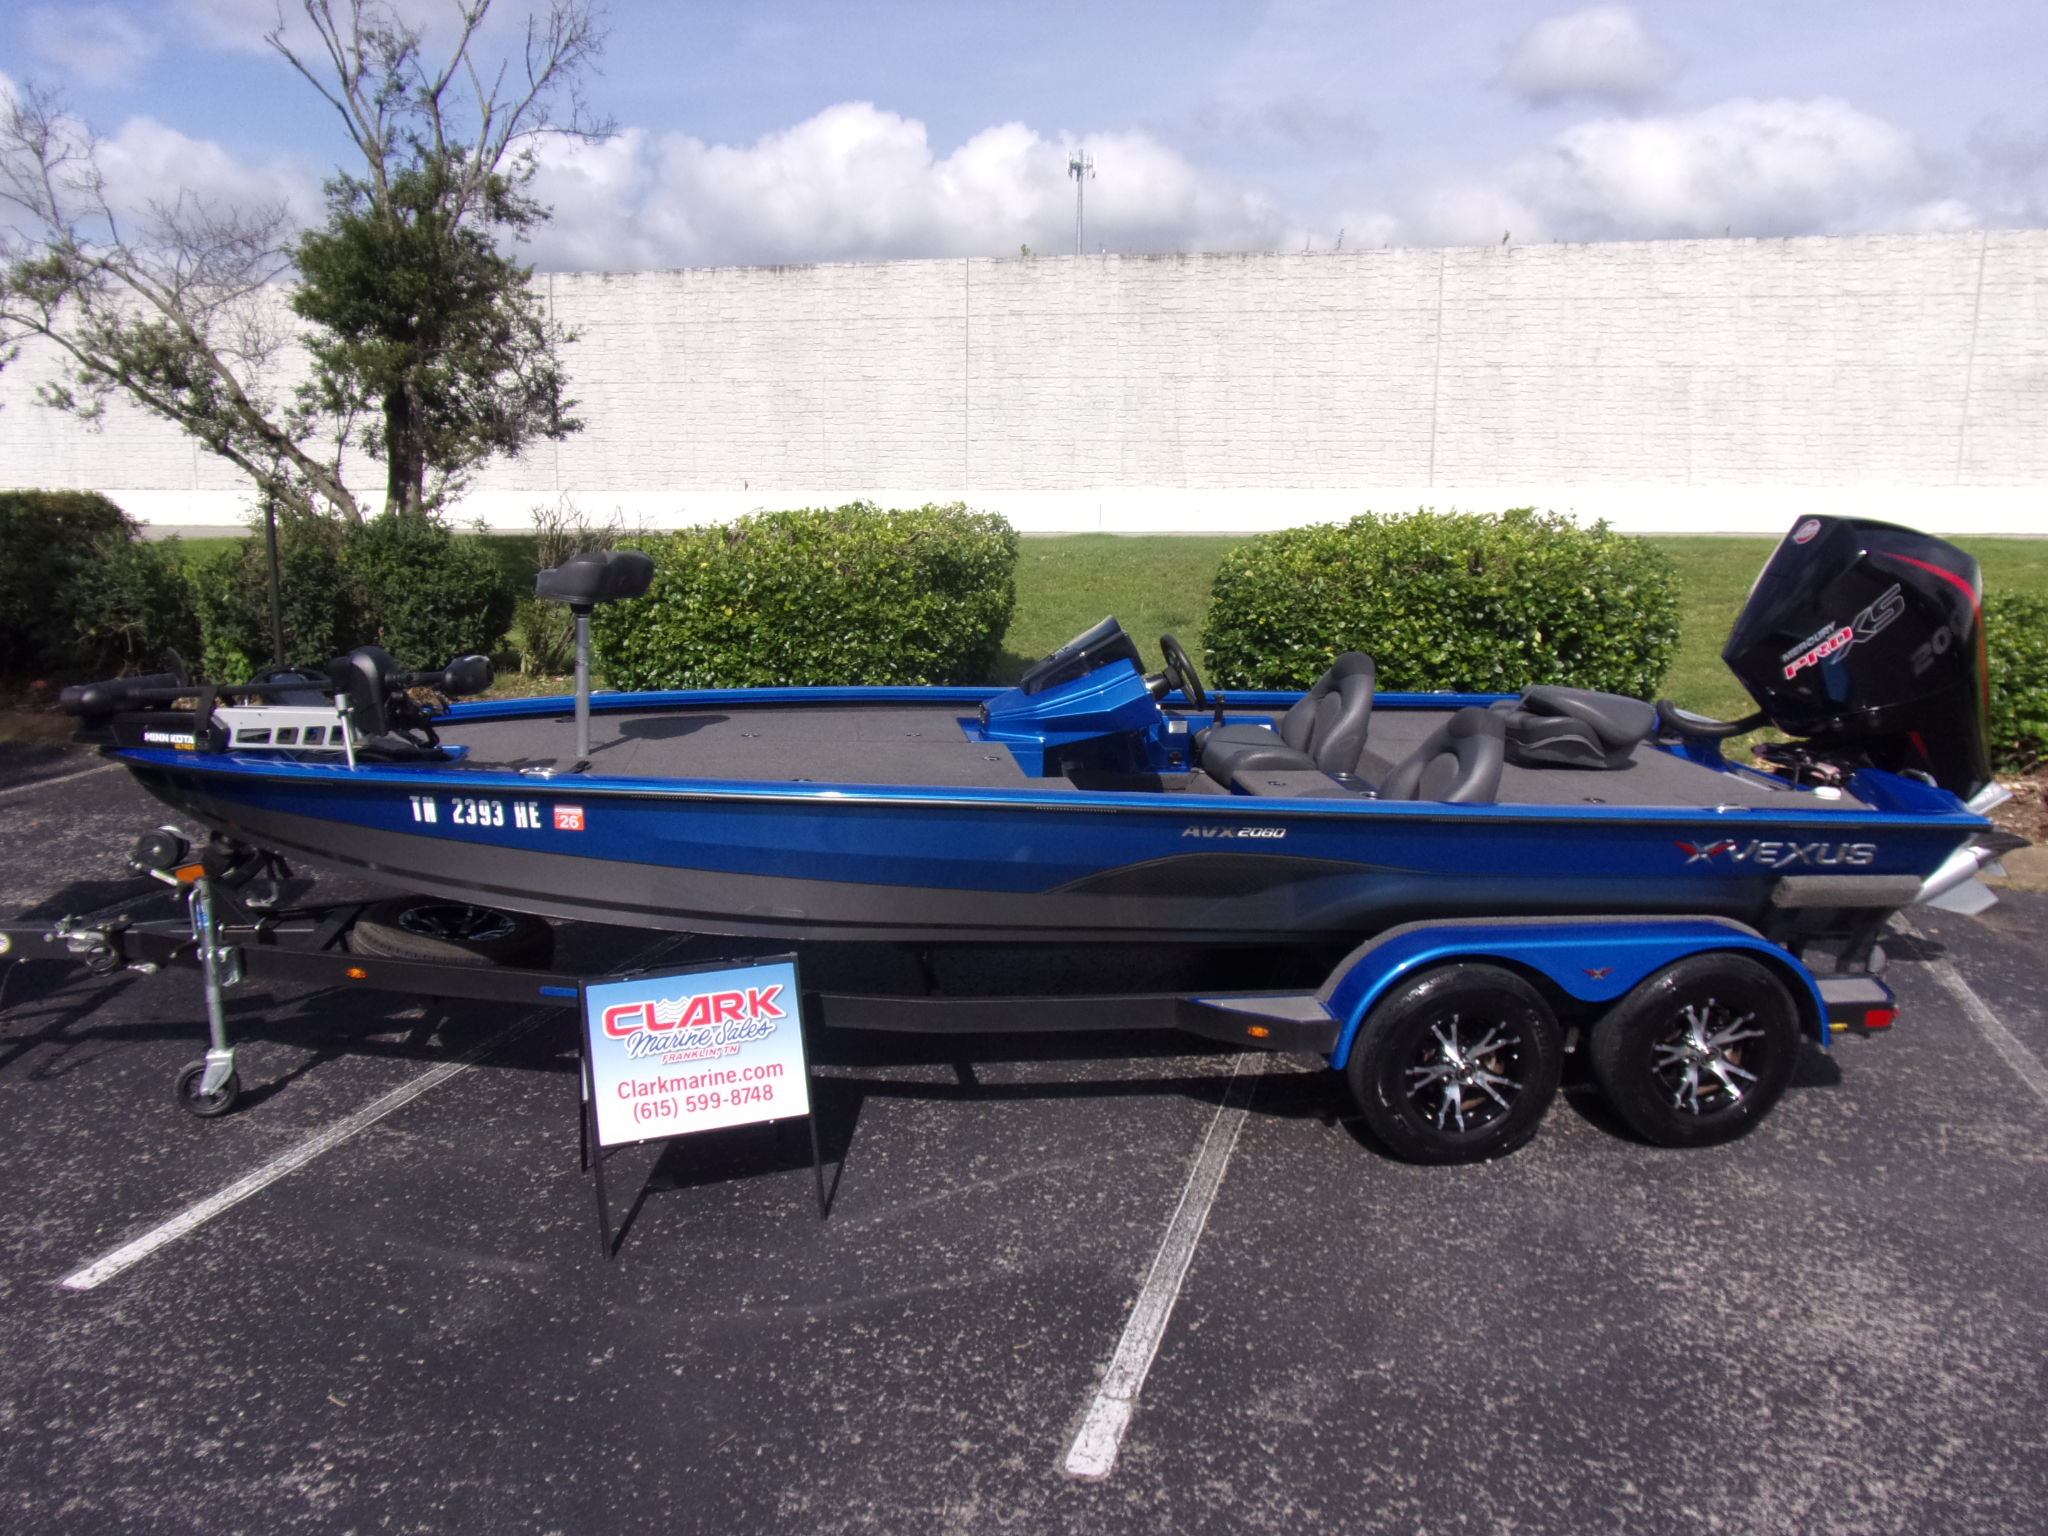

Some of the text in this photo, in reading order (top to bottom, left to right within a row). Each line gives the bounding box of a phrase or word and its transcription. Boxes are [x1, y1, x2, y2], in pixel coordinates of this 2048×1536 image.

[1782, 621, 1836, 662] MERCURY
[1784, 625, 1854, 680] PRO
[144, 732, 195, 744] MINN KOTA
[409, 795, 541, 829] TN 2393 HE
[559, 814, 579, 829] 26
[1181, 825, 1287, 838] AVX 2060
[1726, 839, 1877, 868] VEXUS
[604, 986, 786, 1036] CLARK
[628, 1017, 773, 1056] Marine Sales
[661, 1045, 738, 1063] FRANKLIN, TN
[617, 1062, 784, 1099] Clarkmarine.com
[632, 1084, 774, 1124] (615) 599-8748
